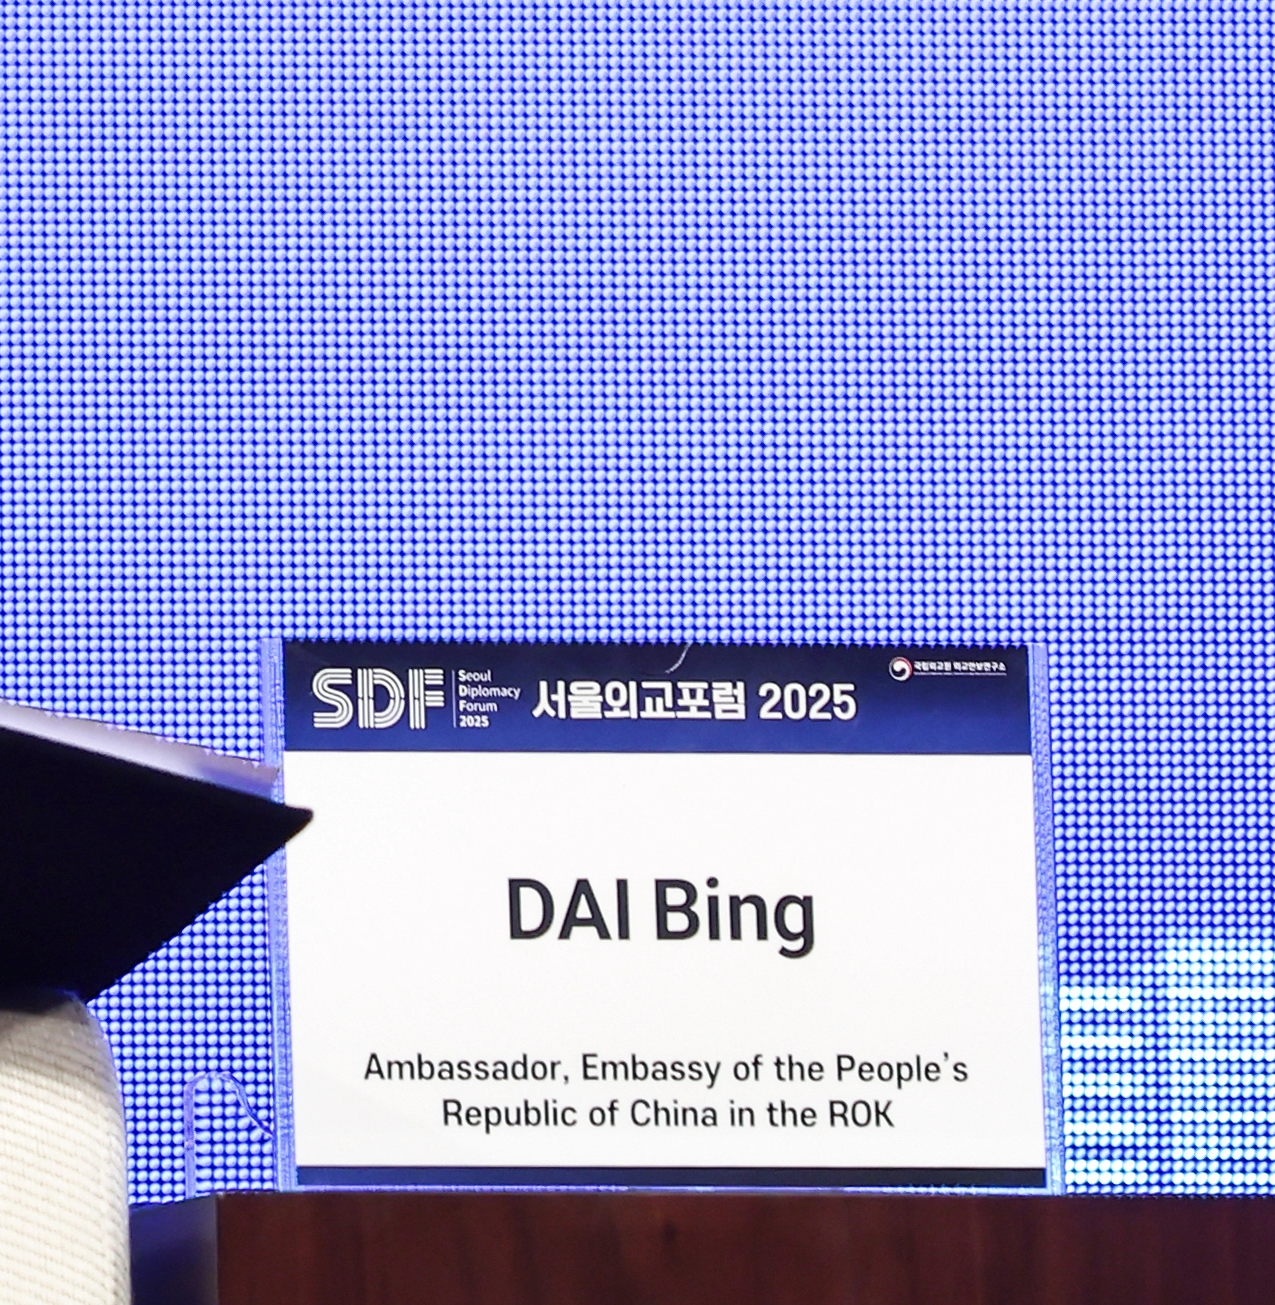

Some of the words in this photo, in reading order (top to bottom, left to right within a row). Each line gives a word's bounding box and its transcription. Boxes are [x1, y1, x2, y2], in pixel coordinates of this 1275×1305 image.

[458, 669, 492, 682] Seoul
[458, 684, 521, 700] Diplomacy
[312, 668, 445, 730] SDF
[458, 699, 498, 712] Forum
[532, 680, 746, 720] 서울외교포럼
[758, 682, 857, 721] 2025
[459, 714, 490, 728] 2025
[508, 878, 631, 941] DAI
[654, 876, 815, 959] Bing
[364, 1052, 570, 1086] Ambassador,
[582, 1053, 721, 1089] Embassy
[733, 1054, 763, 1083] of
[773, 1054, 825, 1083] the
[442, 1098, 577, 1135] Republic
[589, 1099, 619, 1127] of
[630, 1099, 718, 1128] China
[729, 1099, 755, 1128] in
[766, 1099, 817, 1128] the
[829, 1099, 895, 1128] ROK
